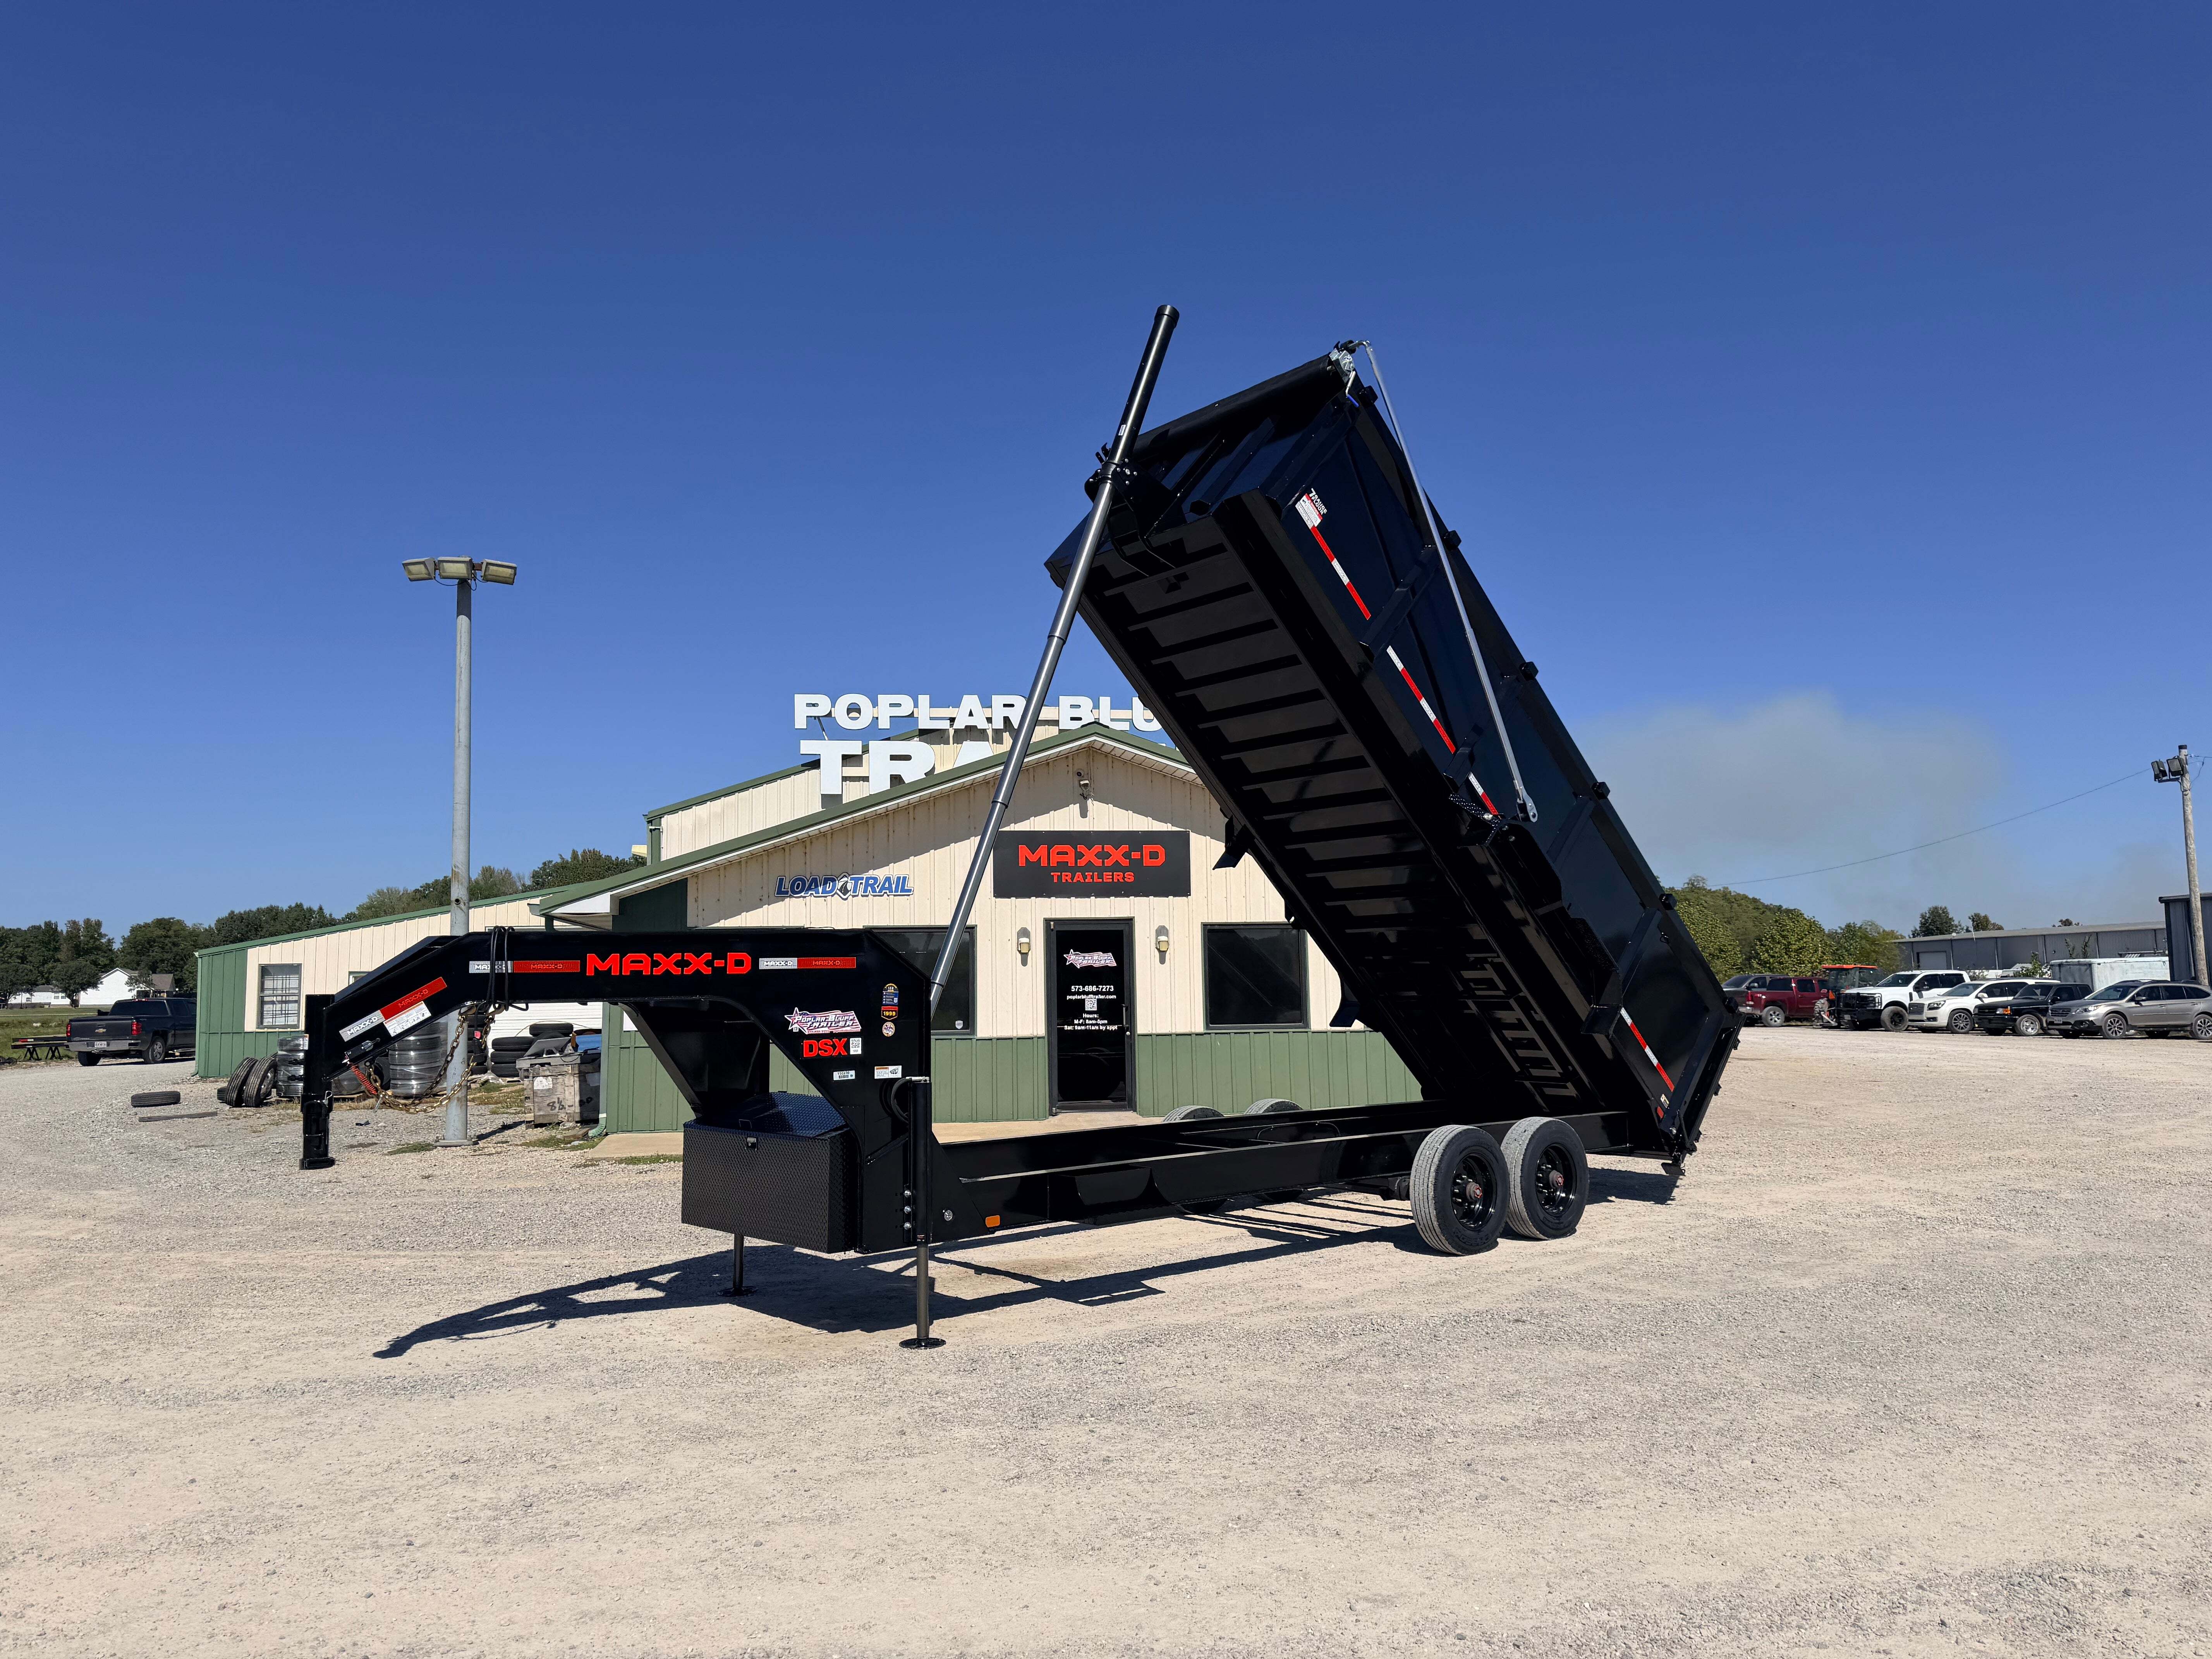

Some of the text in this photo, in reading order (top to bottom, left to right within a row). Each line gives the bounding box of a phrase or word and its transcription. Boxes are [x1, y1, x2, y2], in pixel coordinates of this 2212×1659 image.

[794, 693, 1027, 730] POPLAR
[1019, 845, 1166, 867] MAXX-D
[775, 874, 914, 897] LOAD TRAIL
[1051, 872, 1135, 883] TRAILERS
[586, 952, 751, 976] MAXX-D
[347, 1016, 378, 1036] MAXX-D
[803, 1038, 847, 1057] DSX
